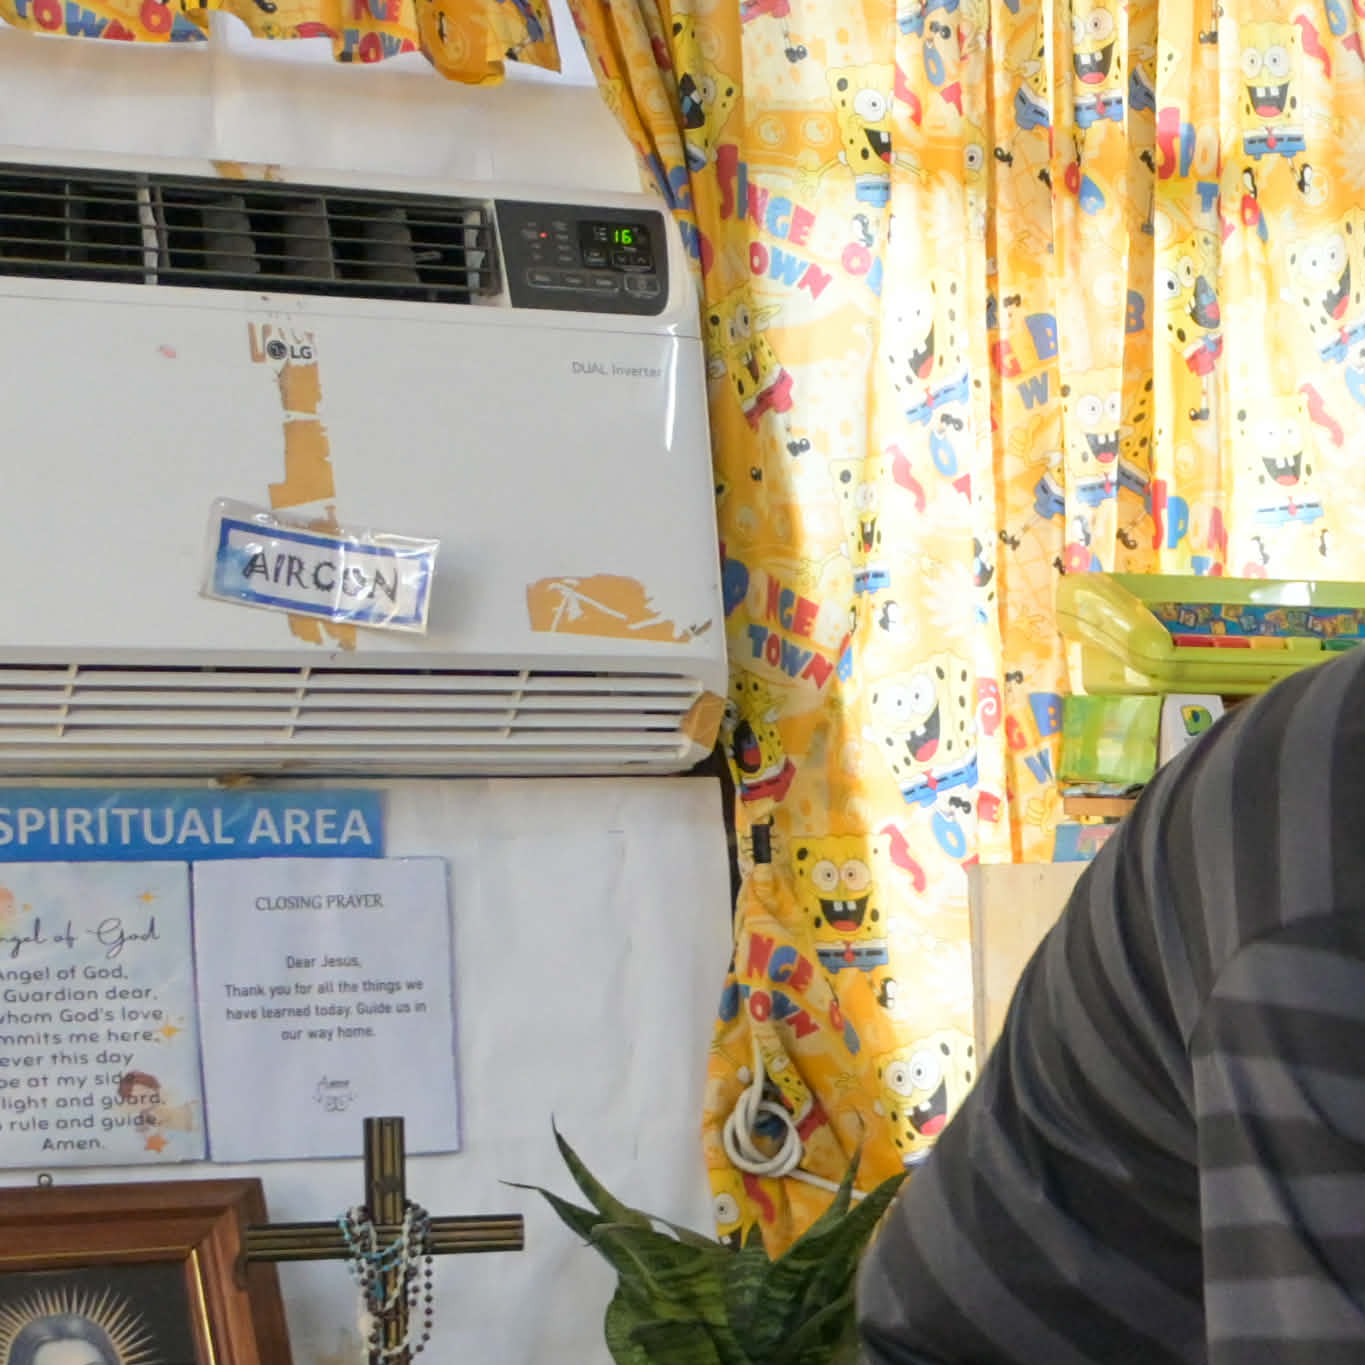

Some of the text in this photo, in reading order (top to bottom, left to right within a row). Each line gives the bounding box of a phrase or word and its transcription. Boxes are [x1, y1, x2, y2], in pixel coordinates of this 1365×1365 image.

[613, 229, 633, 245] 16
[749, 240, 833, 300] OWN
[242, 551, 400, 605] AIRCON
[747, 622, 834, 690] TOWN
[0, 807, 373, 846] SPIRITUAL AREA
[255, 893, 383, 912] CLOSING PRAYER
[0, 917, 48, 959] ngel
[85, 916, 160, 960] God
[285, 955, 316, 969] Dear
[56, 965, 75, 980] of
[3, 986, 99, 1003] Guardian
[225, 979, 424, 999] Thank you for all the things we
[59, 1007, 114, 1022] God's
[121, 1006, 163, 1020] love
[225, 1007, 258, 1020] have
[261, 1004, 311, 1019] learned
[356, 1001, 392, 1016] Guide
[395, 1002, 411, 1013] us
[414, 1000, 427, 1013] in
[0, 1030, 63, 1046] mmits
[69, 1030, 99, 1043] me
[281, 1027, 302, 1041] our
[307, 1029, 334, 1041] way
[51, 1052, 88, 1066] this
[95, 1050, 135, 1067] day
[27, 1074, 49, 1089] at
[57, 1074, 86, 1090] my
[2, 1095, 48, 1113] light
[55, 1094, 94, 1109] and
[9, 1117, 49, 1131] rule
[55, 1115, 95, 1130] and
